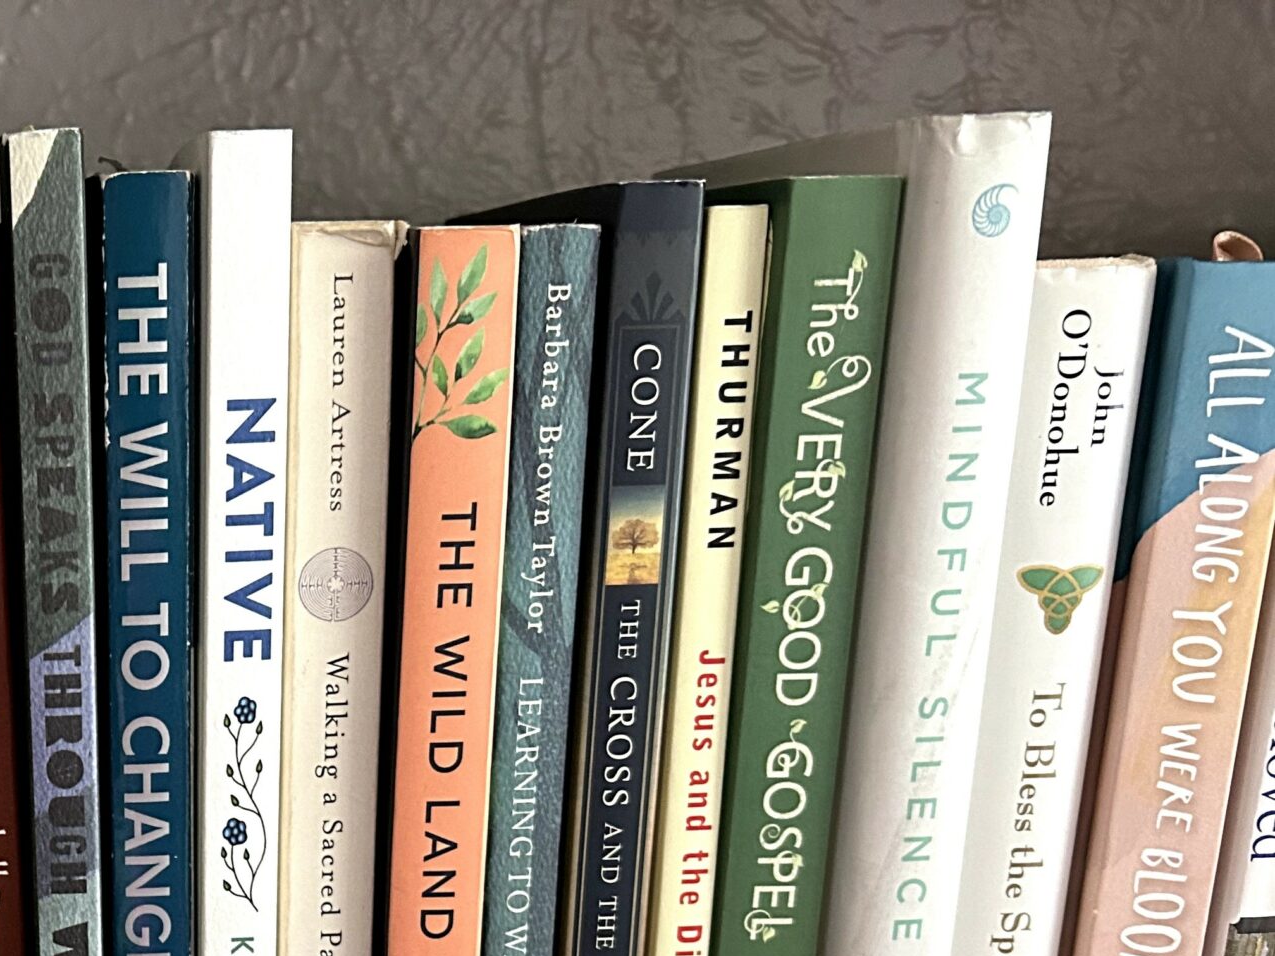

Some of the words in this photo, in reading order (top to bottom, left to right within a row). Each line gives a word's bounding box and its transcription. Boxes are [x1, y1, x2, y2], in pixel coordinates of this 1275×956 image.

[29, 252, 73, 365] GOD
[117, 262, 168, 395] THE
[333, 272, 354, 387] Lauren
[540, 283, 573, 410] Barbara
[806, 258, 862, 357] The
[626, 343, 662, 473] CONE
[1090, 366, 1124, 448] John
[1206, 325, 1275, 418] ALL
[330, 399, 352, 512] Artress
[536, 423, 564, 528] Brown
[707, 310, 753, 551] THURMAN
[780, 356, 871, 534] VERY
[34, 393, 79, 615] SPEAKS
[119, 422, 169, 582] WILL
[224, 398, 276, 663] NATIVE
[436, 502, 478, 610] THE
[925, 372, 988, 657] MINDFUL
[1192, 434, 1260, 585] ALONG
[526, 534, 558, 636] Taylor
[617, 598, 640, 660] THE
[774, 546, 833, 706] GOOD
[121, 602, 170, 691] TO
[693, 650, 725, 751] Jesus
[1172, 600, 1233, 704] YOU
[313, 652, 350, 779] Walking
[428, 635, 471, 775] WILD
[603, 676, 638, 807] CROSS
[1029, 682, 1067, 728] To
[43, 644, 88, 895] THROUGH
[322, 792, 336, 805] a
[508, 677, 543, 861] LEARNING
[685, 769, 712, 833] and
[892, 696, 949, 942] SILENCE
[1013, 741, 1056, 833] Bless
[1156, 723, 1202, 833] WERE
[320, 820, 342, 917] Sacred
[417, 800, 461, 940] LAND
[506, 866, 531, 912] TO
[601, 822, 624, 886] AND
[680, 848, 710, 905] the
[743, 735, 813, 940] GOSPEL
[1005, 846, 1044, 900] the
[595, 895, 617, 951] THE
